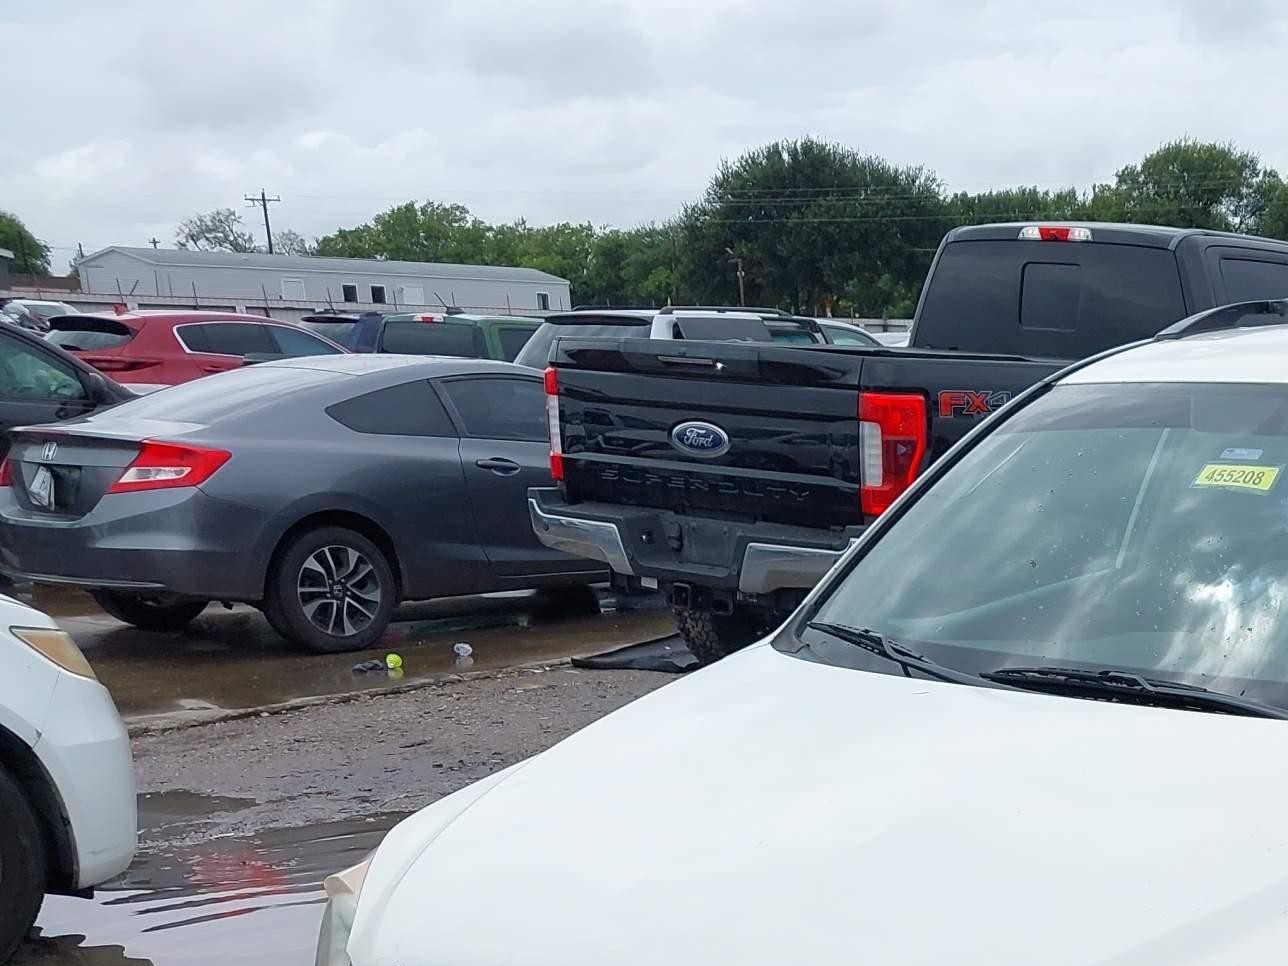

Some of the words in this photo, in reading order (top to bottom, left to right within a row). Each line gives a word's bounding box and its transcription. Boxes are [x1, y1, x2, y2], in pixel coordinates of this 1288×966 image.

[684, 427, 714, 448] Ford
[600, 467, 709, 490] SUPER
[711, 481, 811, 501] DUTY
[1204, 468, 1266, 487] 455208
